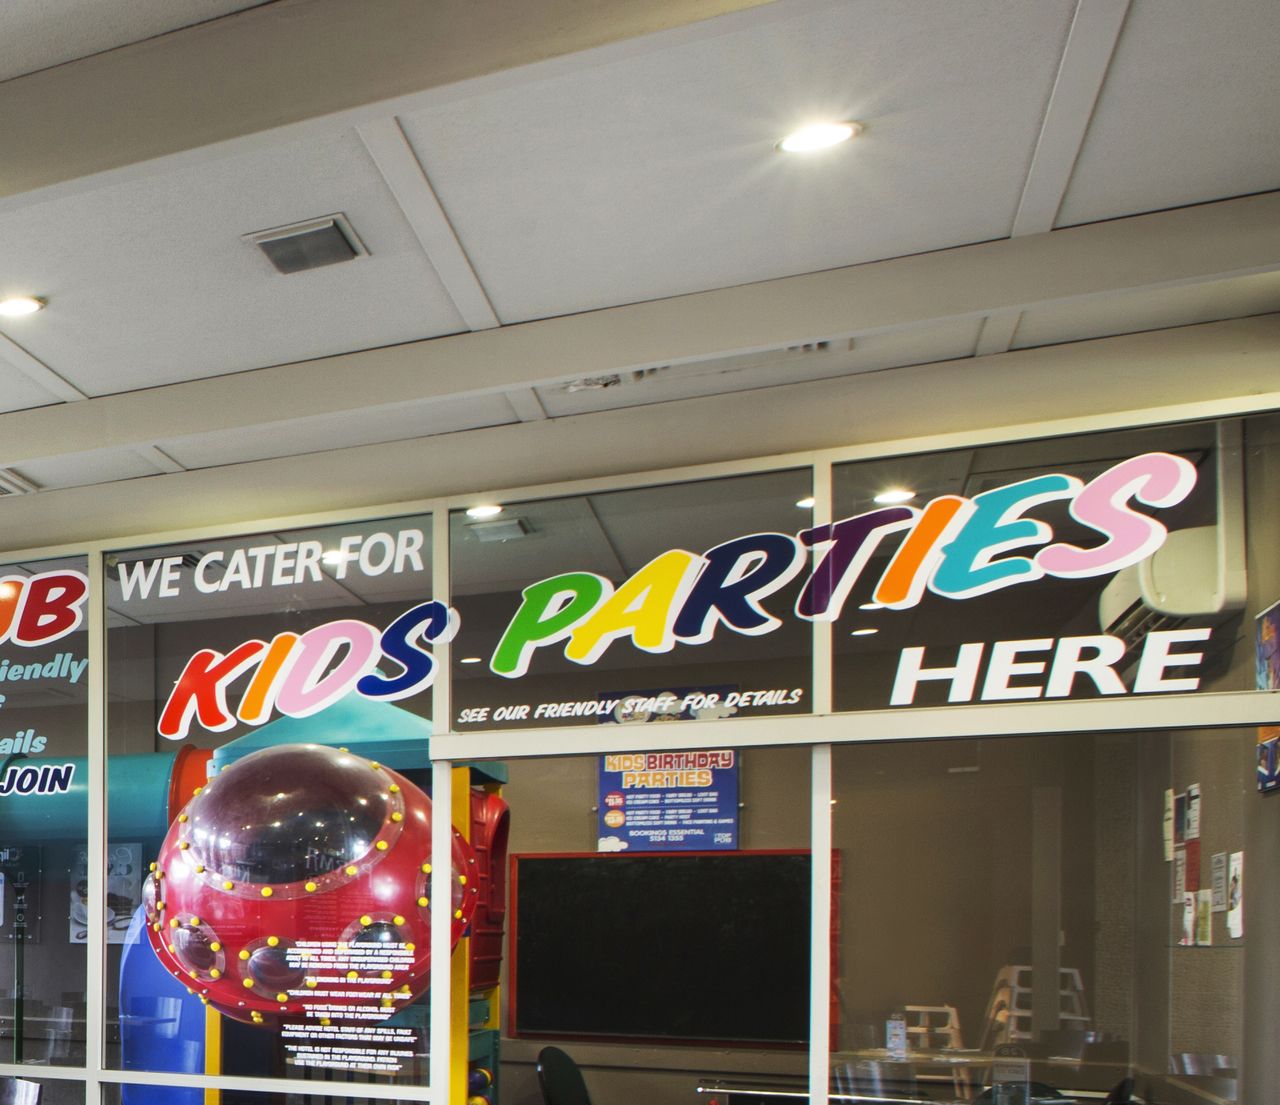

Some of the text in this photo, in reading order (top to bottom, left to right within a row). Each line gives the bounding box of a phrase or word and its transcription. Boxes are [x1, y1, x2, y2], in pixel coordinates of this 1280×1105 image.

[118, 528, 425, 602] WE CATER FOR
[490, 451, 1199, 680] PARTIES
[156, 600, 460, 741] KIDS
[889, 627, 1212, 706] HERE
[458, 688, 803, 724] SEE OUR FRIENDLY STAFF FOR DETAILS
[604, 750, 734, 772] KIDS BIRTHDAY
[622, 770, 713, 789] PARTIES
